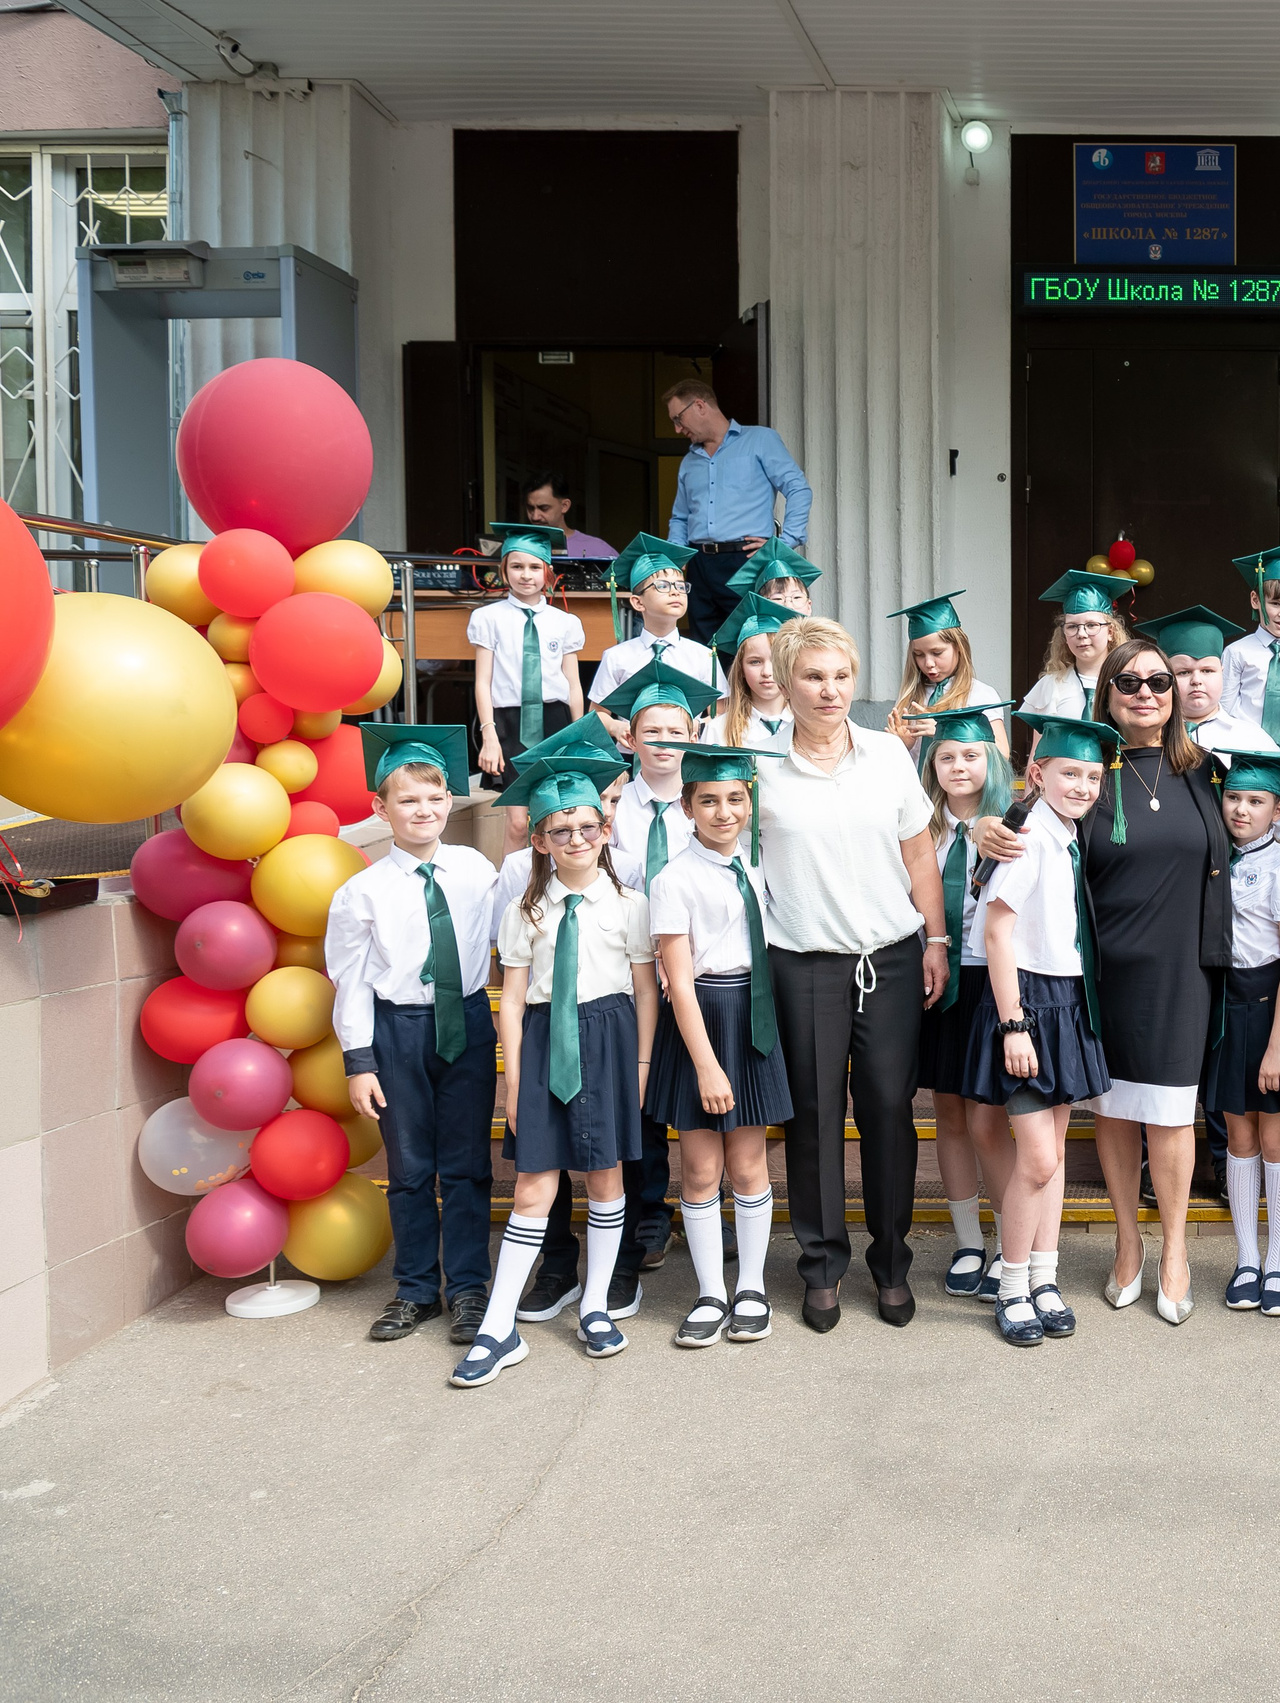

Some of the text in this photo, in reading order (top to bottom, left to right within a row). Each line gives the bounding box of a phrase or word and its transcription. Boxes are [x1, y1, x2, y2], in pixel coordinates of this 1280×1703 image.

[1083, 227, 1228, 240] «ШКОЛА № 1287»
[1031, 278, 1100, 300] ГБОУ
[1108, 278, 1182, 300] Школа
[1193, 279, 1219, 301] №
